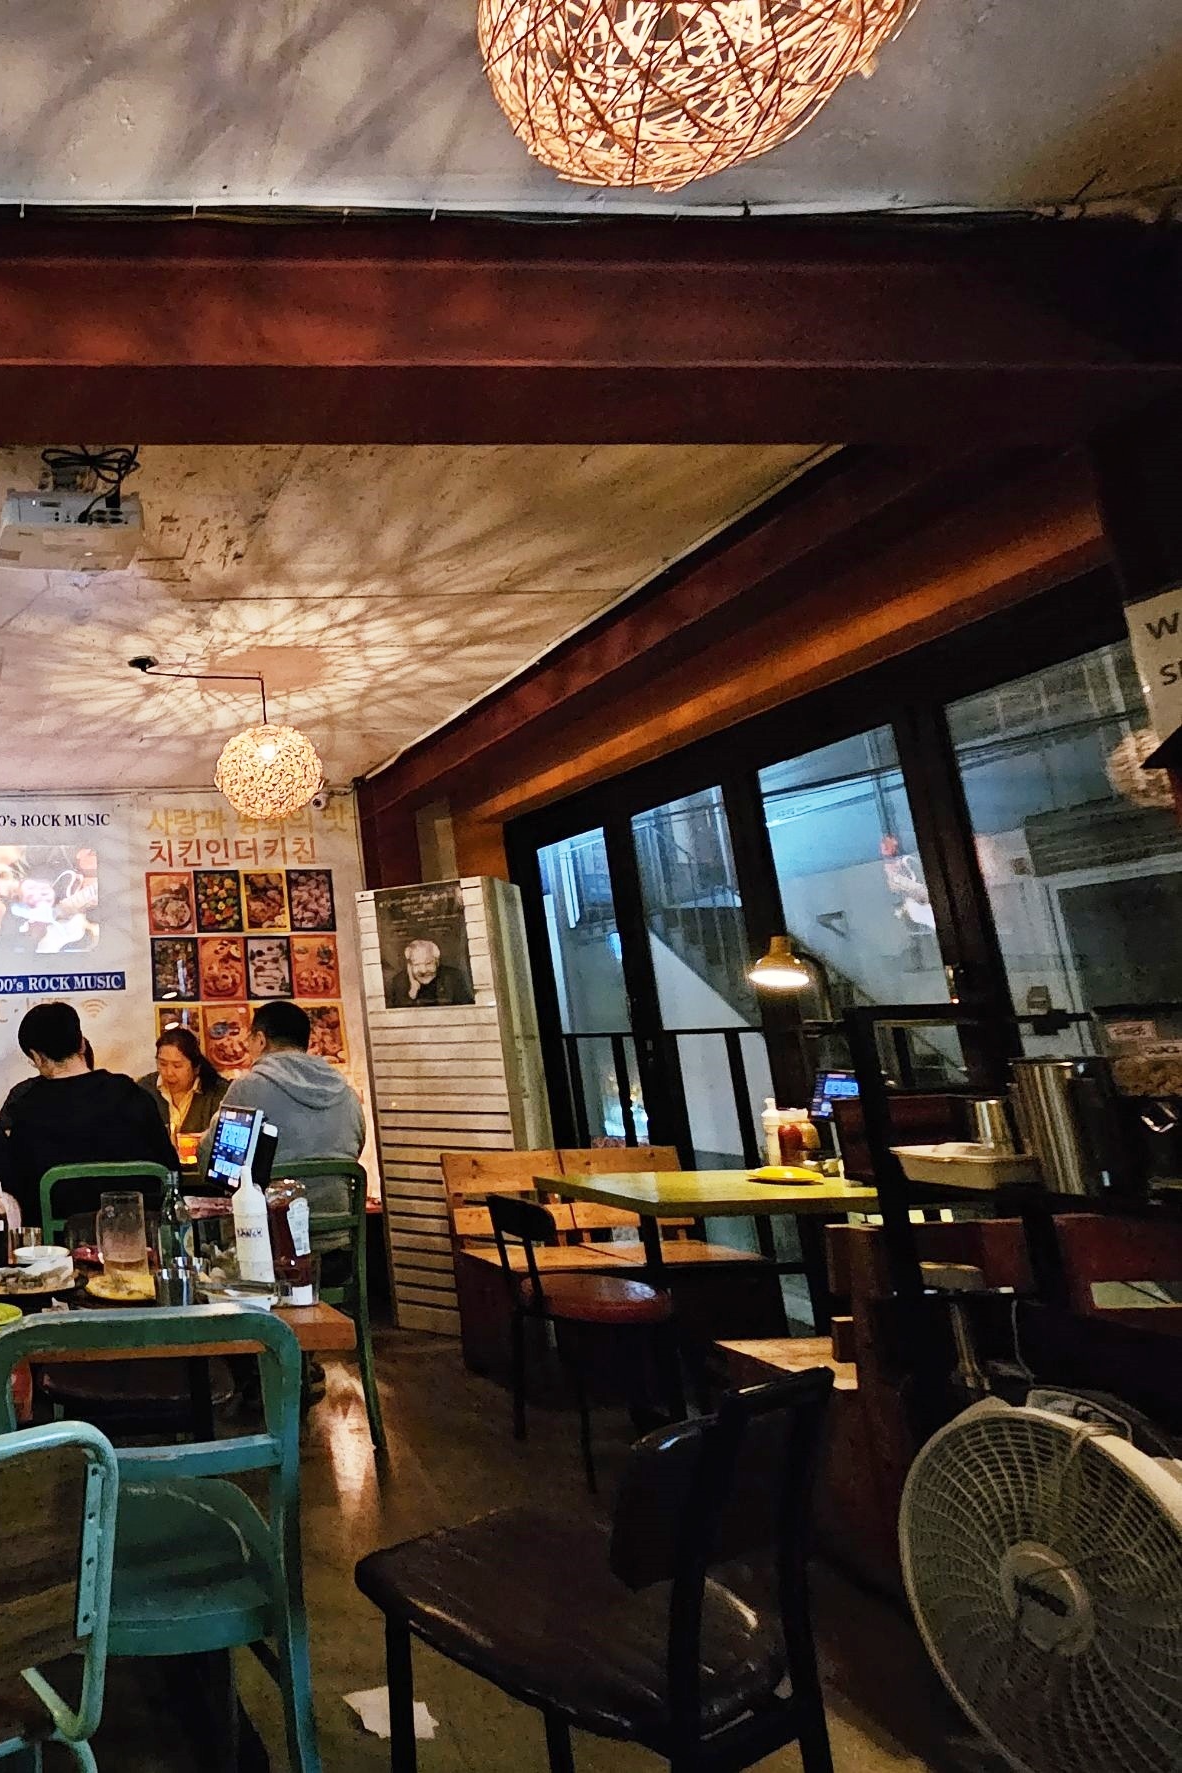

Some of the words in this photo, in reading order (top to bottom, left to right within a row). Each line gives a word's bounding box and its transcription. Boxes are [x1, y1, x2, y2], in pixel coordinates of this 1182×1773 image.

[21, 814, 61, 827] ROCK
[64, 813, 110, 826] MUSIC
[146, 807, 226, 836] 사랑과
[149, 837, 317, 868] 치킨인더키친
[28, 976, 70, 991] ROCK
[73, 975, 122, 990] MUSIC
